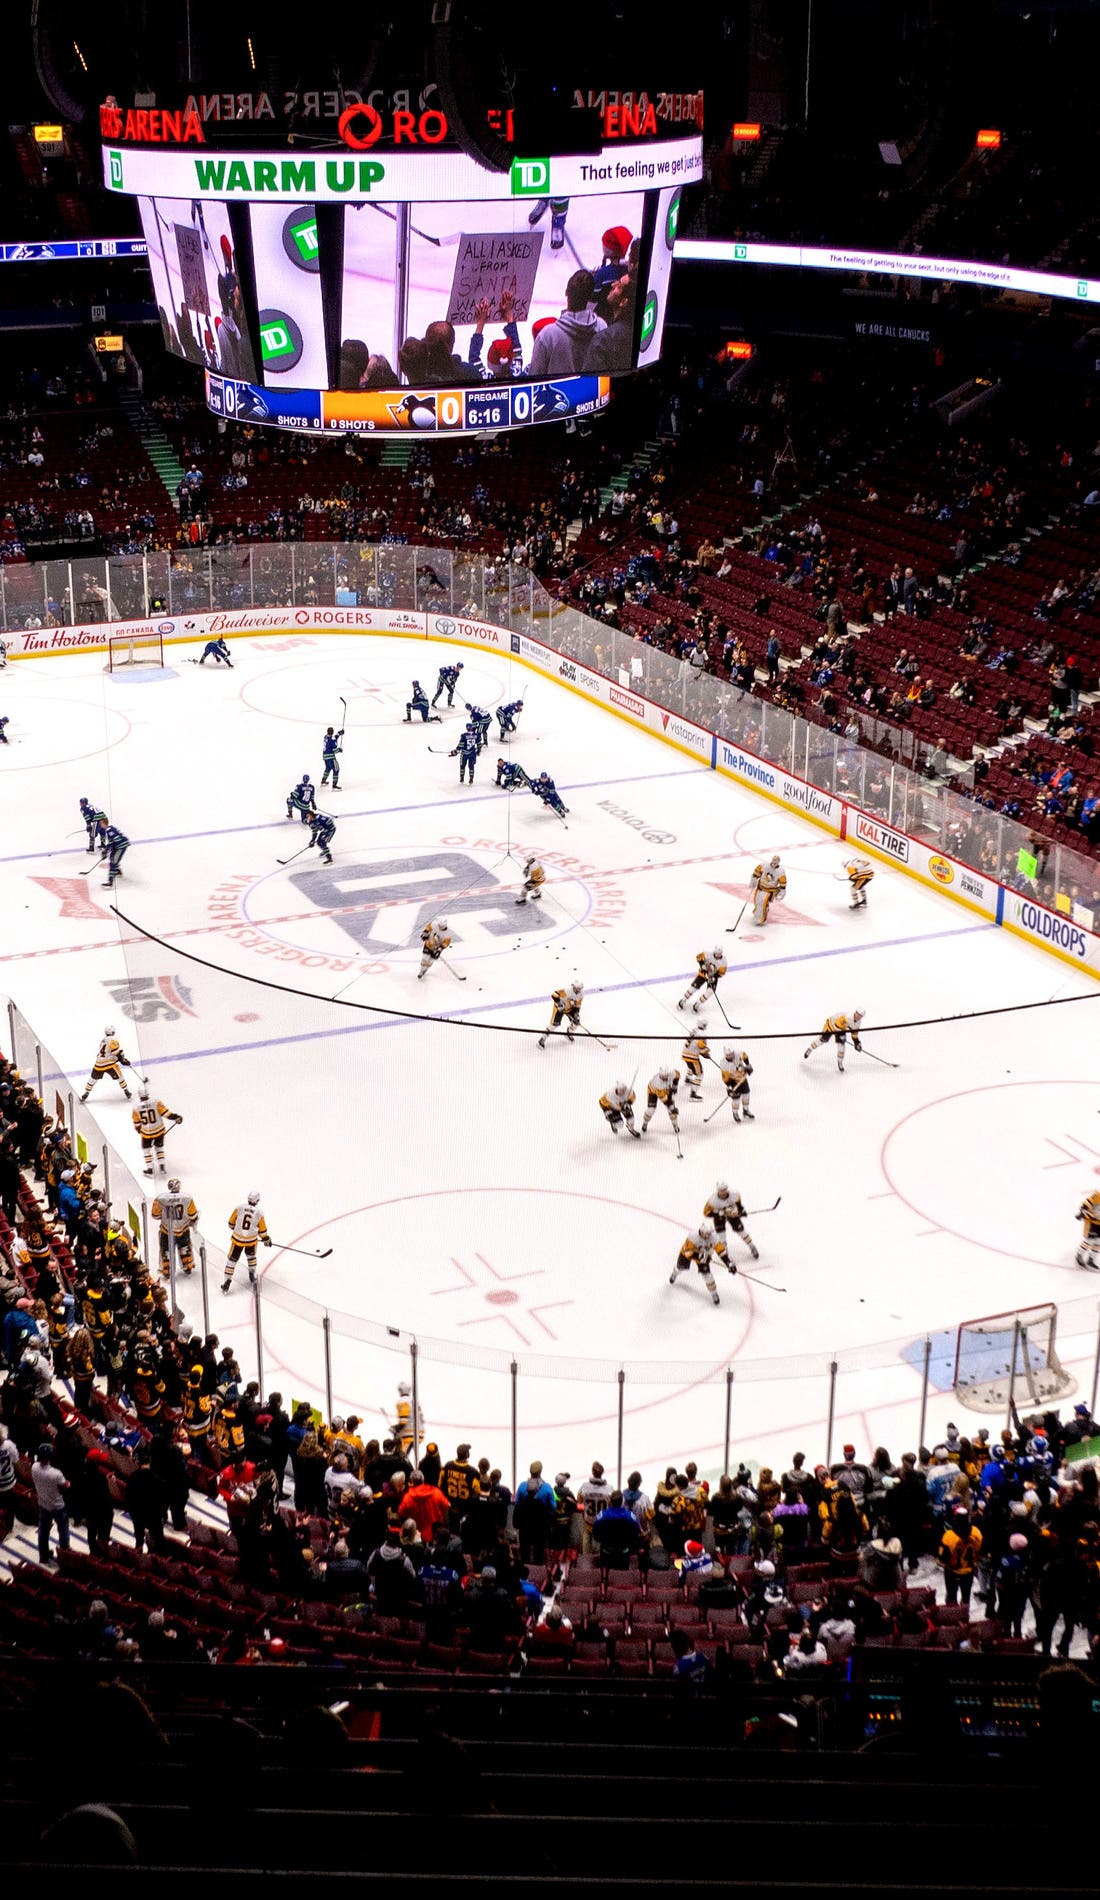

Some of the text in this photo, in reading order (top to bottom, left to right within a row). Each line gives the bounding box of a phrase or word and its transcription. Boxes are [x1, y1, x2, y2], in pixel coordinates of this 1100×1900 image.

[125, 109, 205, 142] ARENA
[194, 160, 385, 192] WARM UP
[514, 162, 547, 188] TD
[580, 164, 612, 181] That
[615, 160, 655, 178] feeling
[657, 161, 670, 174] we
[671, 157, 684, 175] get
[464, 240, 486, 260] ALL
[490, 239, 495, 259] I
[480, 261, 509, 273] FROM
[458, 275, 517, 297] SANTA
[856, 323, 929, 342] WE ARE ALL CANUCKS
[226, 385, 235, 413] 0
[468, 391, 508, 402] PREGAME
[514, 391, 530, 420] 0
[576, 400, 594, 414] SHOTS
[278, 415, 320, 428] SHOTS 0
[441, 397, 460, 425] 0
[468, 408, 501, 425] 6:16
[330, 420, 375, 430] 0 SHOTS
[206, 613, 290, 632] Budweiser
[313, 612, 373, 625] ROGERS
[21, 633, 48, 651] Tim
[51, 629, 106, 648] Hortons
[457, 623, 499, 643] TOYOTA
[562, 660, 577, 673] PLAY
[564, 670, 577, 682] NOW
[580, 672, 600, 692] SPORTS
[670, 722, 705, 749] vistaprint
[723, 747, 775, 788] The Province
[783, 780, 833, 816] goodfood
[859, 820, 907, 857] KAL TIRE
[473, 838, 596, 874] ROGERS
[207, 874, 261, 920] ARENA
[583, 881, 626, 928] ARENA
[1021, 902, 1086, 957] COLDROPS
[225, 929, 357, 971] ROGERS
[139, 1108, 157, 1126] 50
[242, 1214, 252, 1231] 6
[447, 1477, 470, 1500] 66
